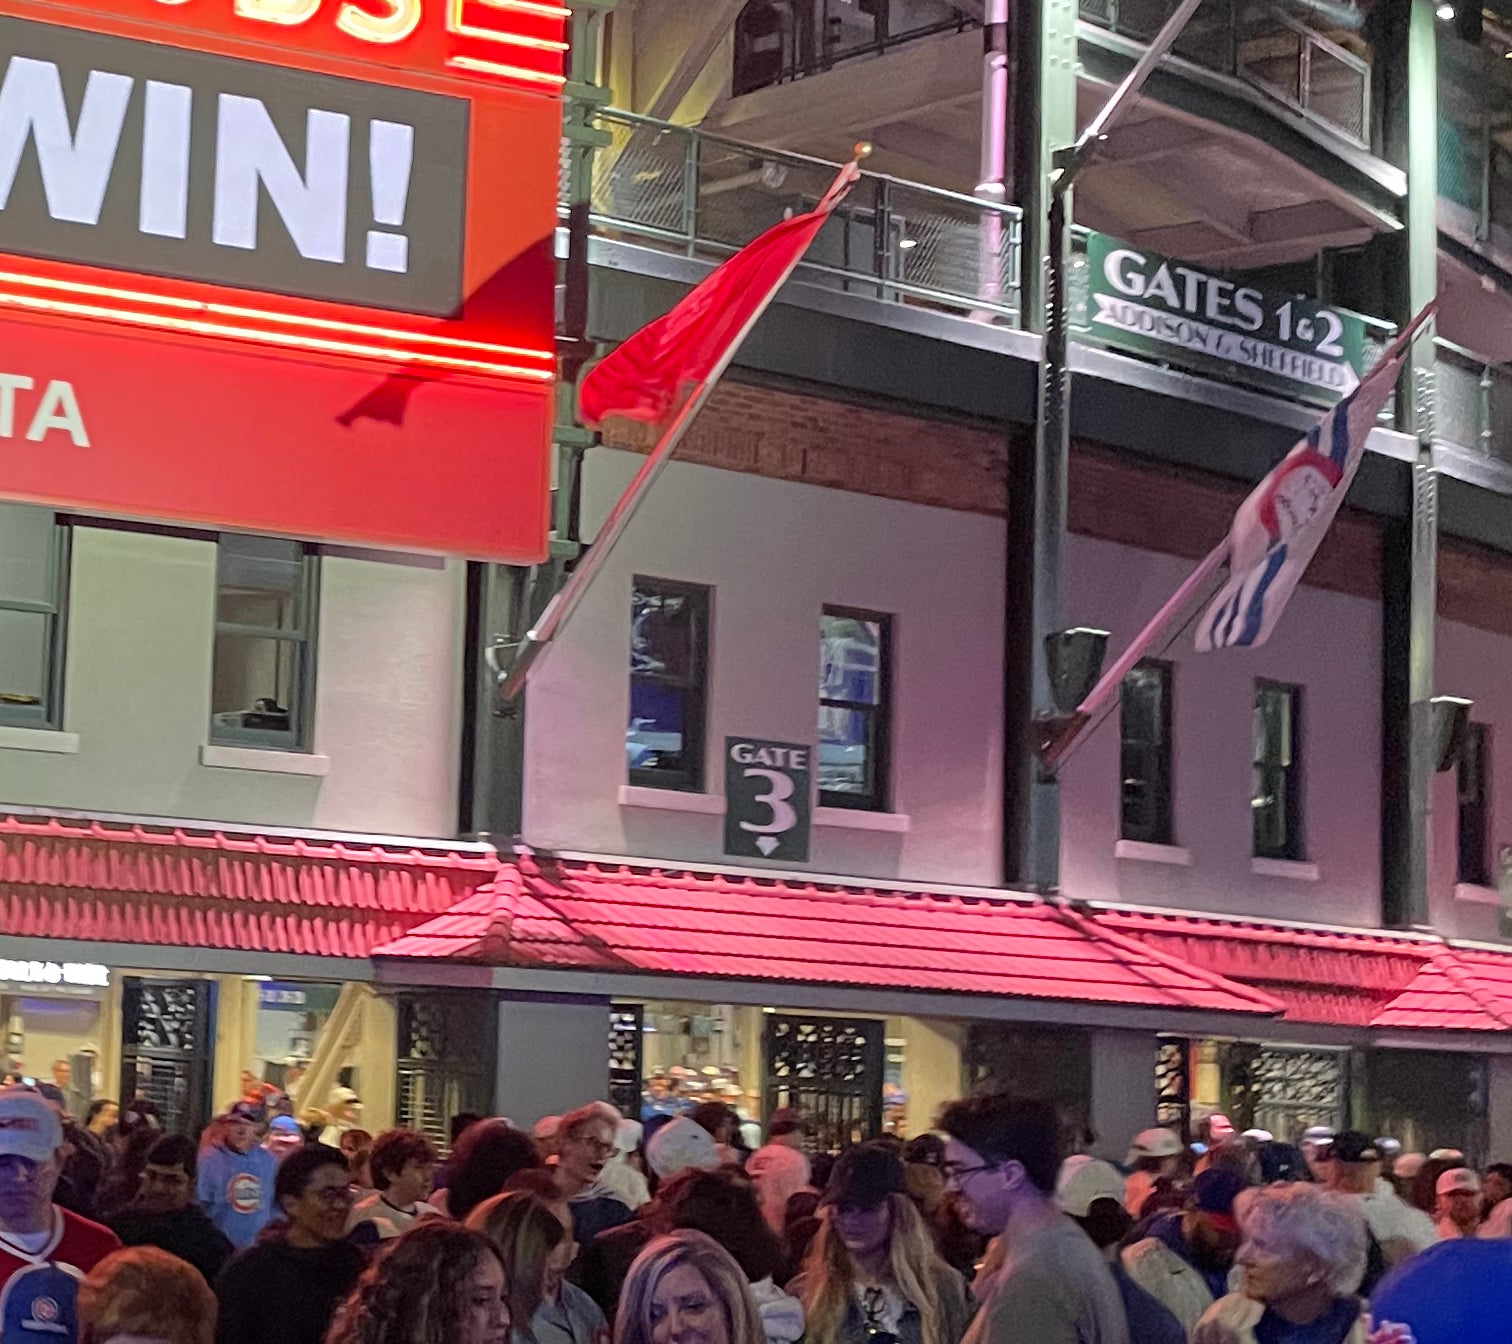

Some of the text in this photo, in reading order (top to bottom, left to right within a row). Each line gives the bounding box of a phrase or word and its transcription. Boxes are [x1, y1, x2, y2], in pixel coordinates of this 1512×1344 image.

[1103, 248, 1264, 332] GATES
[1103, 302, 1210, 349] ADDISON
[1239, 339, 1346, 388] SHEFFIELD
[730, 742, 807, 770] GATE
[739, 767, 798, 834] 3
